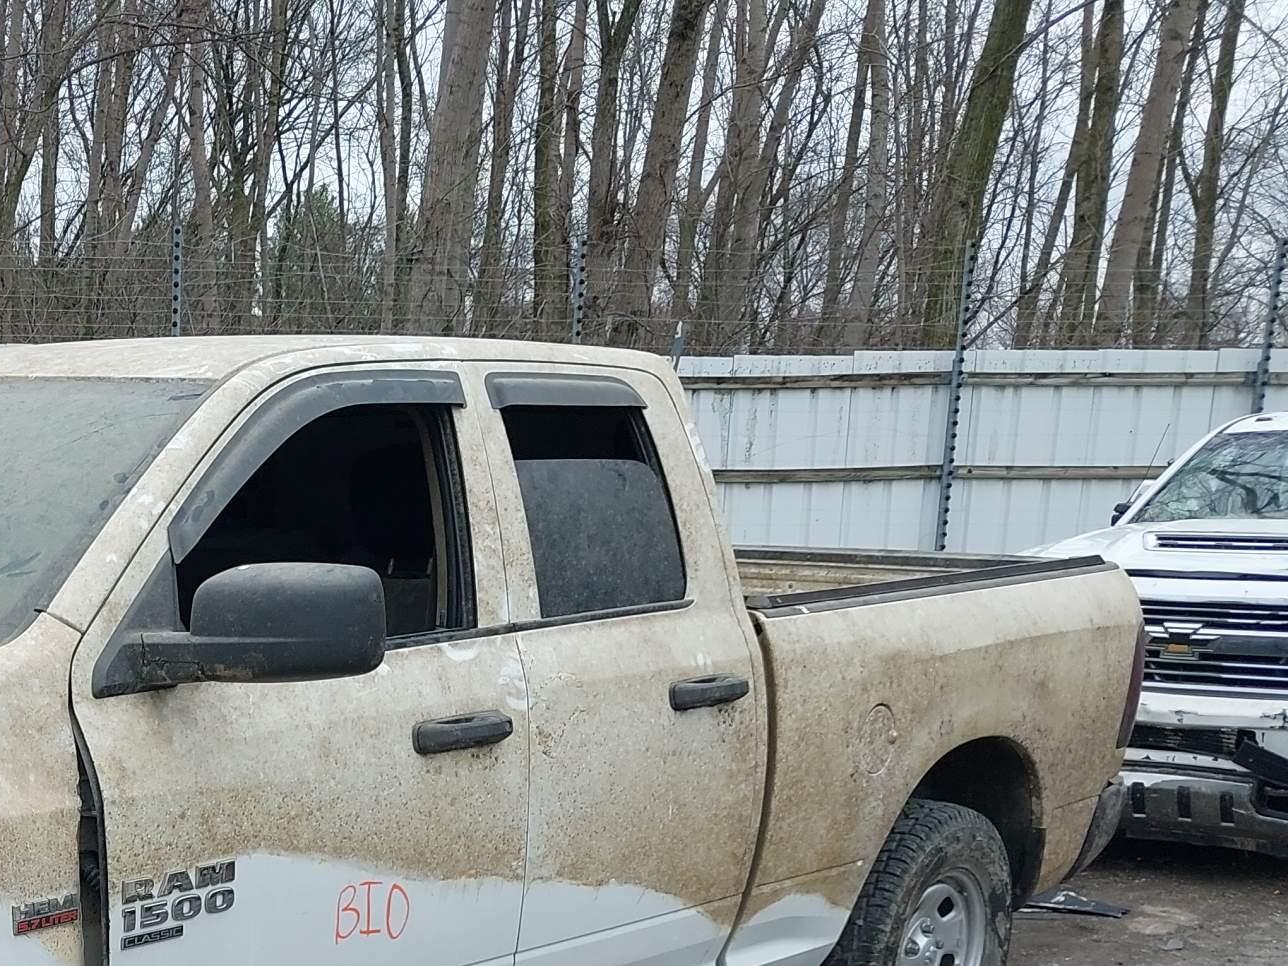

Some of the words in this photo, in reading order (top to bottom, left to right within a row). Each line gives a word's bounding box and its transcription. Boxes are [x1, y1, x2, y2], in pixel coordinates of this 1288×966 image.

[121, 858, 236, 905] RAM
[122, 886, 235, 933] 1500
[335, 881, 410, 945] BIO
[123, 926, 183, 948] CLASSIC
